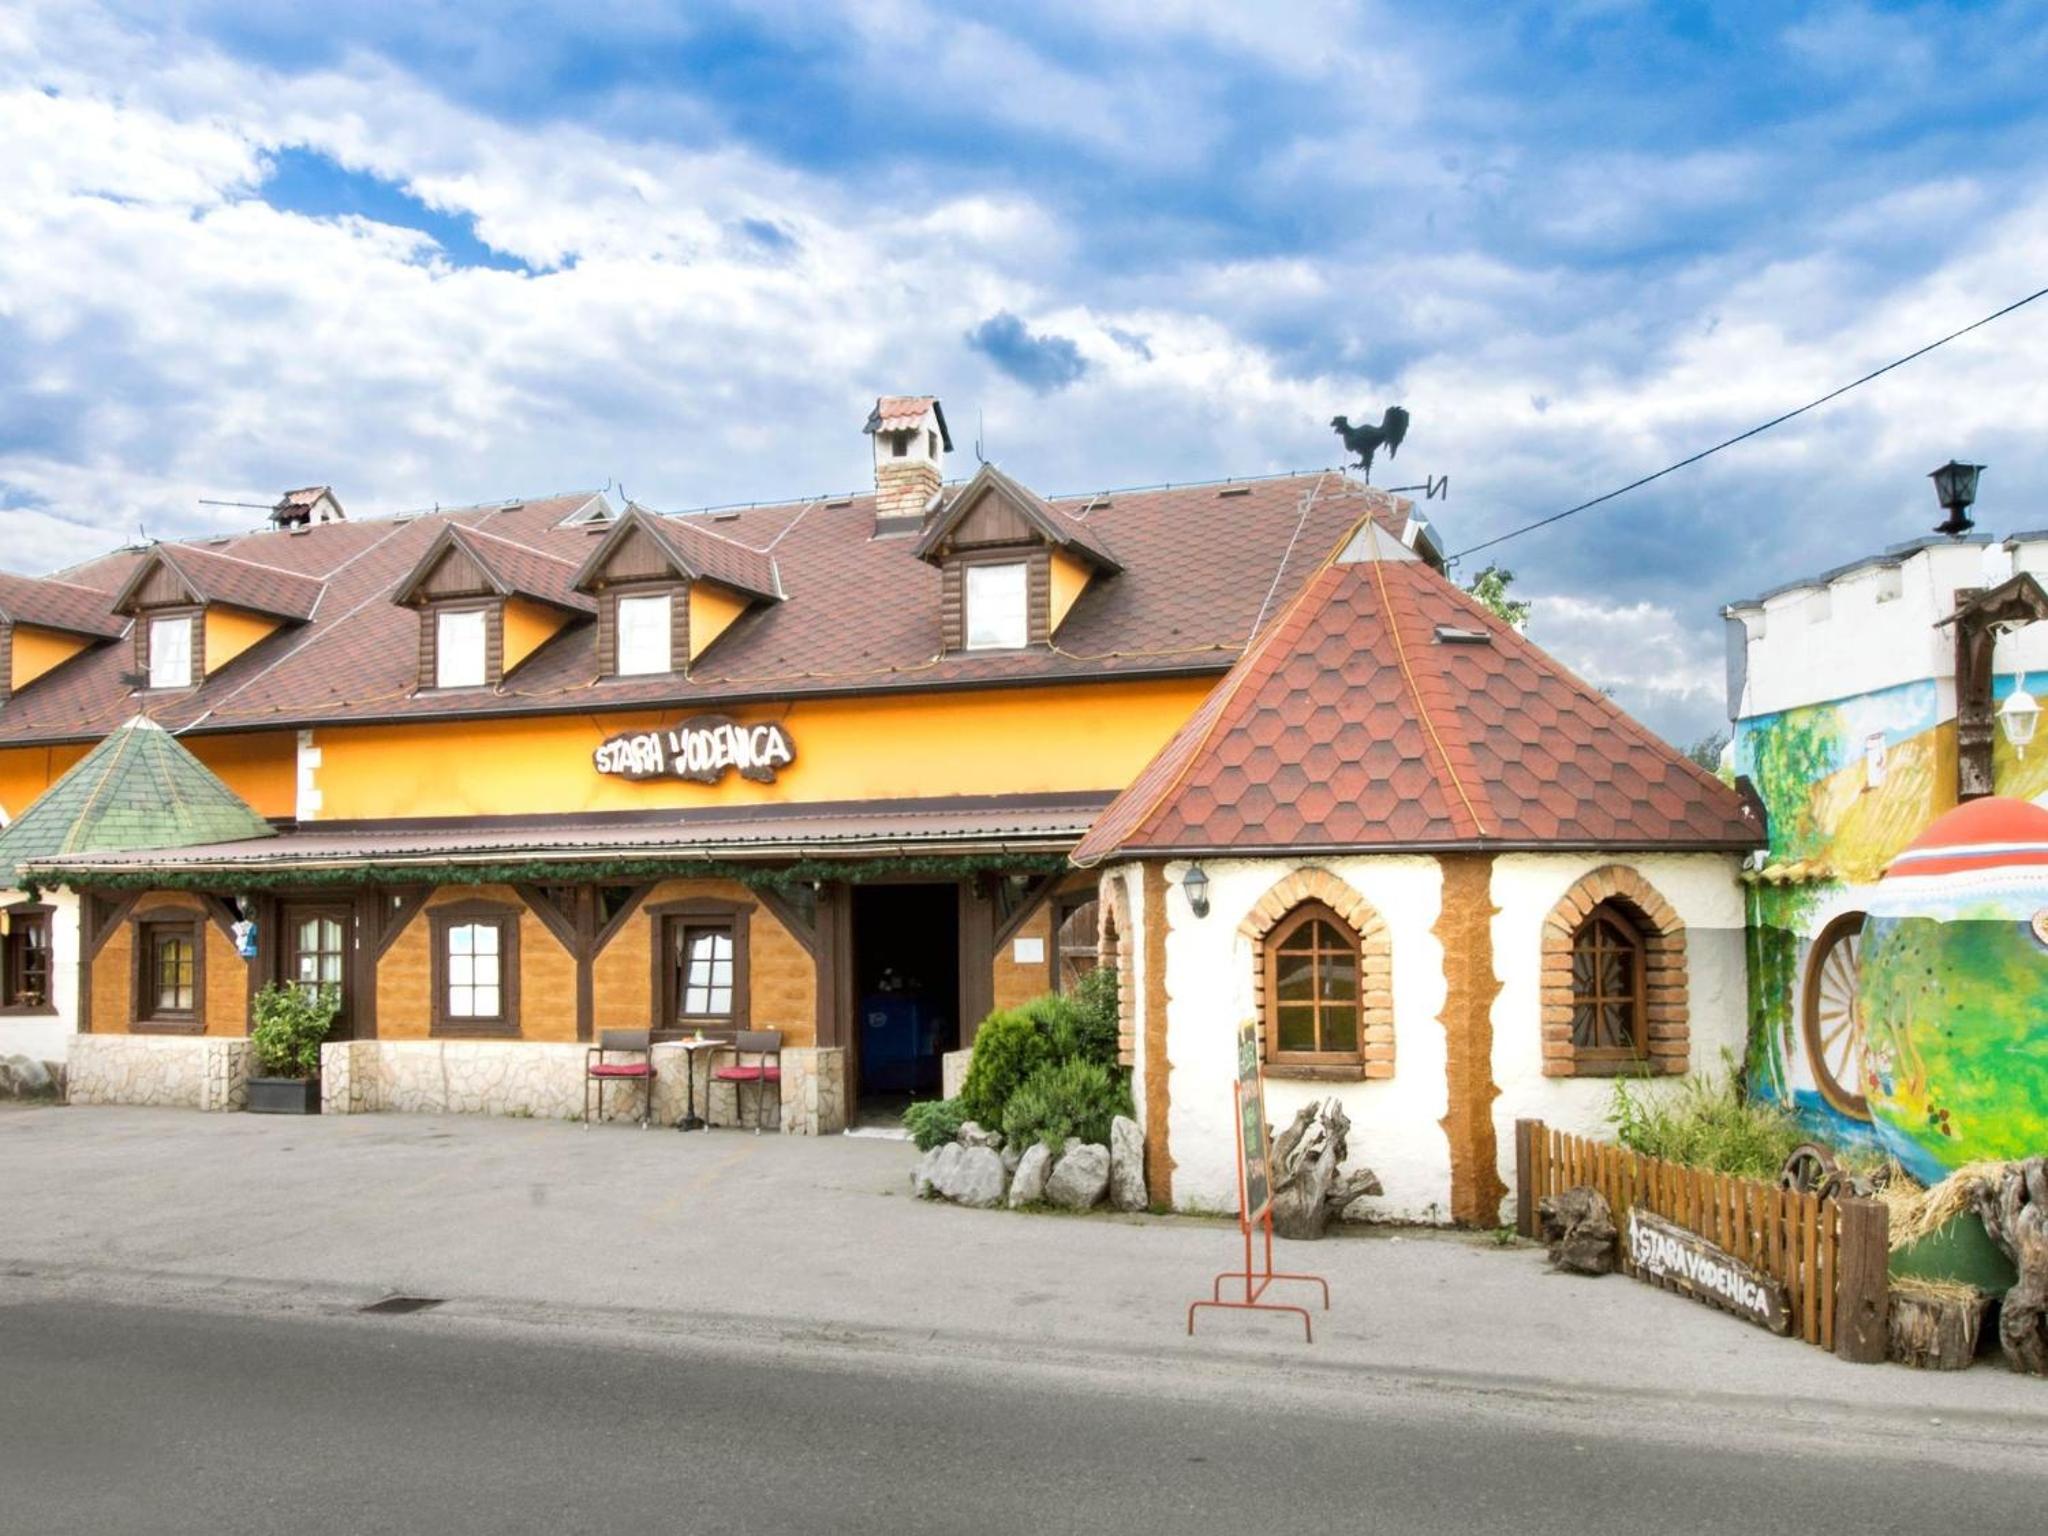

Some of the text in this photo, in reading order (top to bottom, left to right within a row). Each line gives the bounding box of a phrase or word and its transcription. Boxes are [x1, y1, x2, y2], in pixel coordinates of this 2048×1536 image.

[595, 732, 664, 774] STARA
[1638, 1227, 1770, 1317] STARA VODENICA
